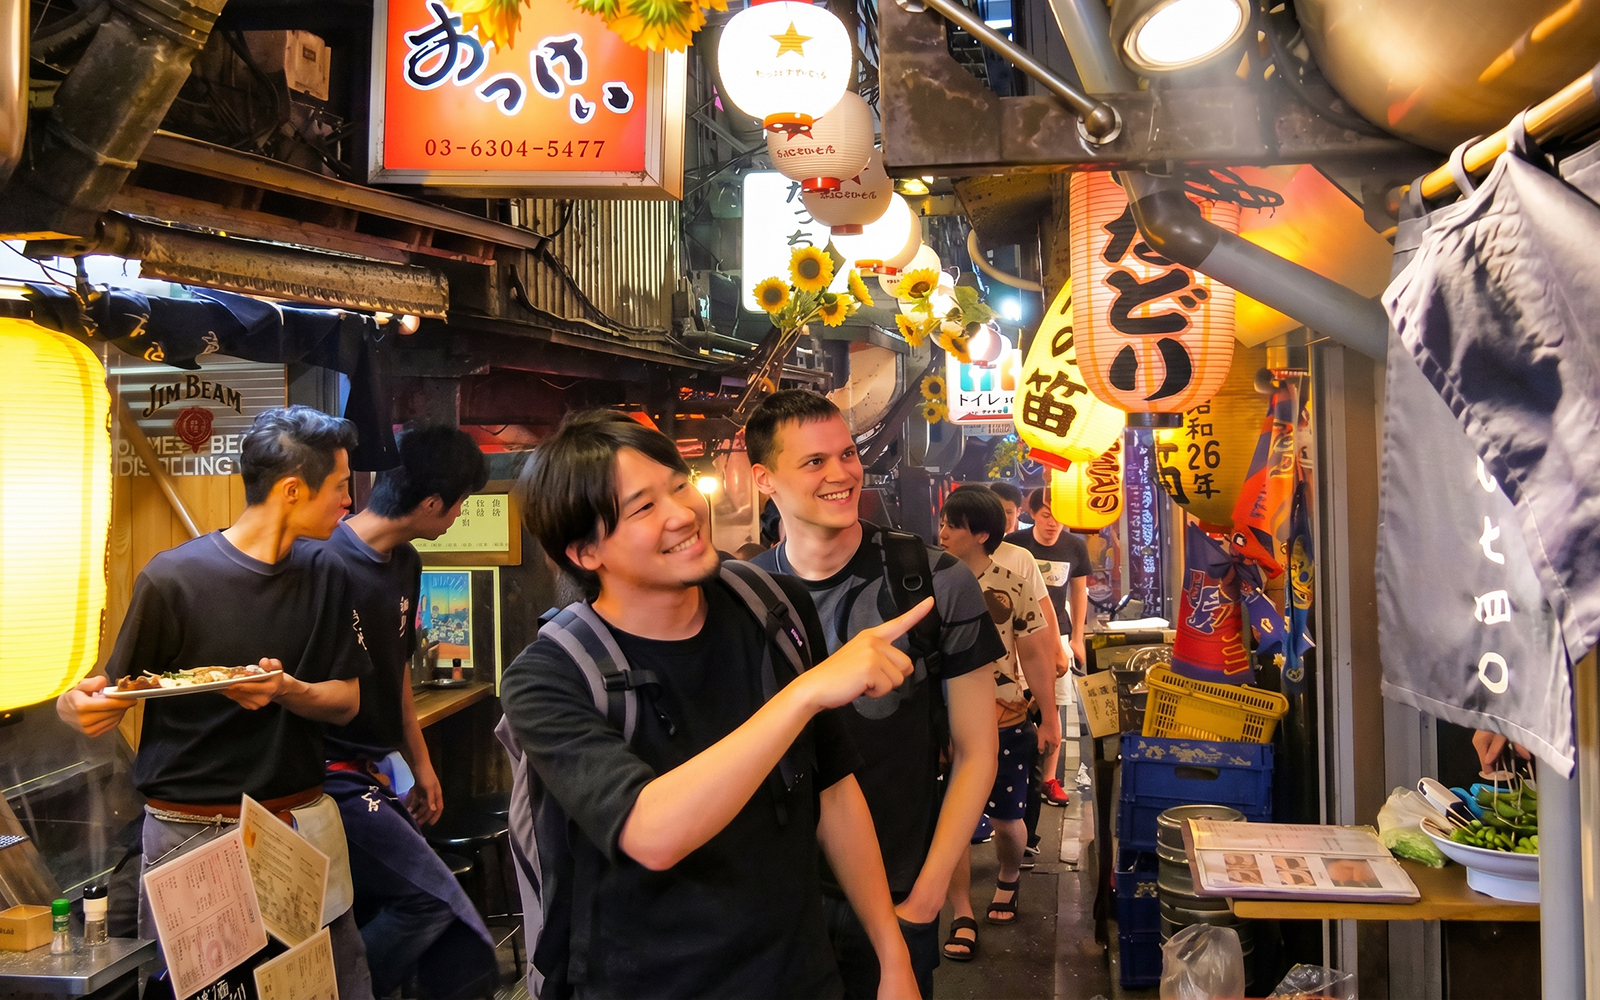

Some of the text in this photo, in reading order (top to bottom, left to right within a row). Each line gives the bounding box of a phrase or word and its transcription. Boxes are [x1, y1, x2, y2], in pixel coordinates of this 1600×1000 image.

[425, 139, 606, 158] 03-6304-5477
[142, 374, 243, 418] JIM BEAM
